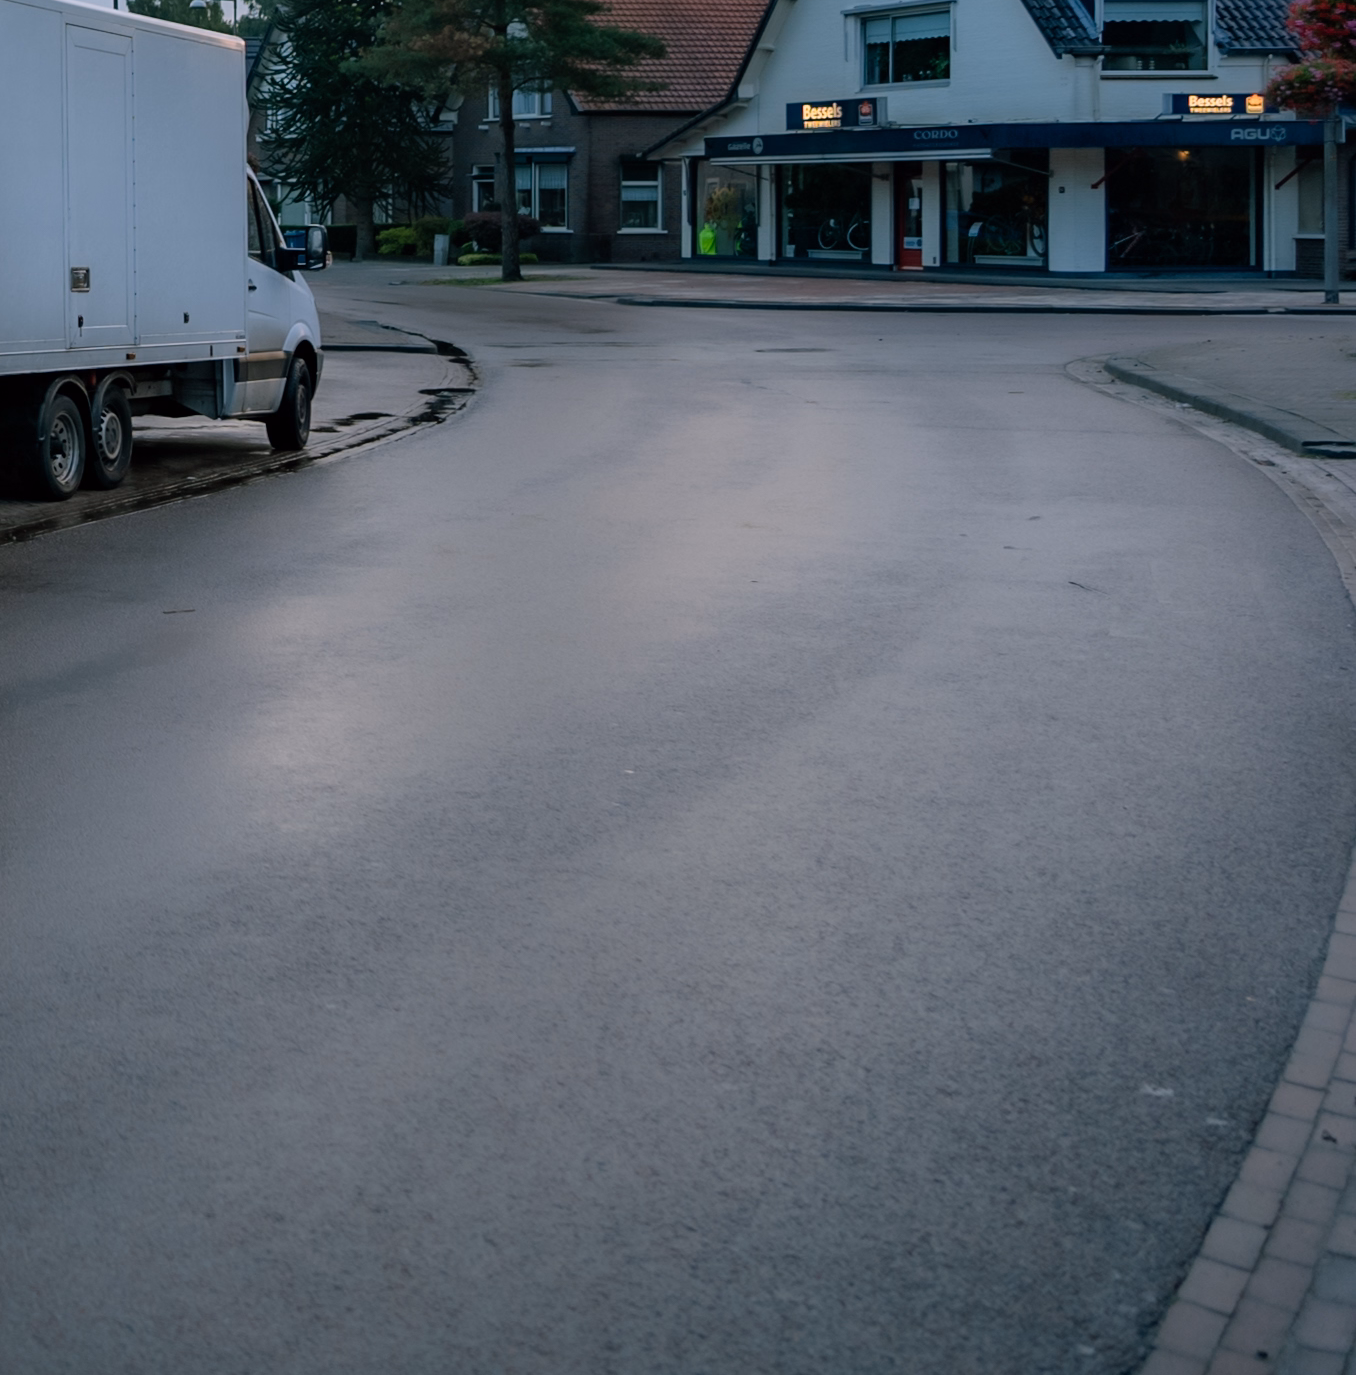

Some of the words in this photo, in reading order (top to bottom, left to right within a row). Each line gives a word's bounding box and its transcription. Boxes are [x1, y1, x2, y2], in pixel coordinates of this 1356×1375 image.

[1188, 95, 1233, 107] Bessels
[802, 102, 842, 120] Bessels
[913, 129, 959, 140] CORDO
[1230, 128, 1270, 140] AGU
